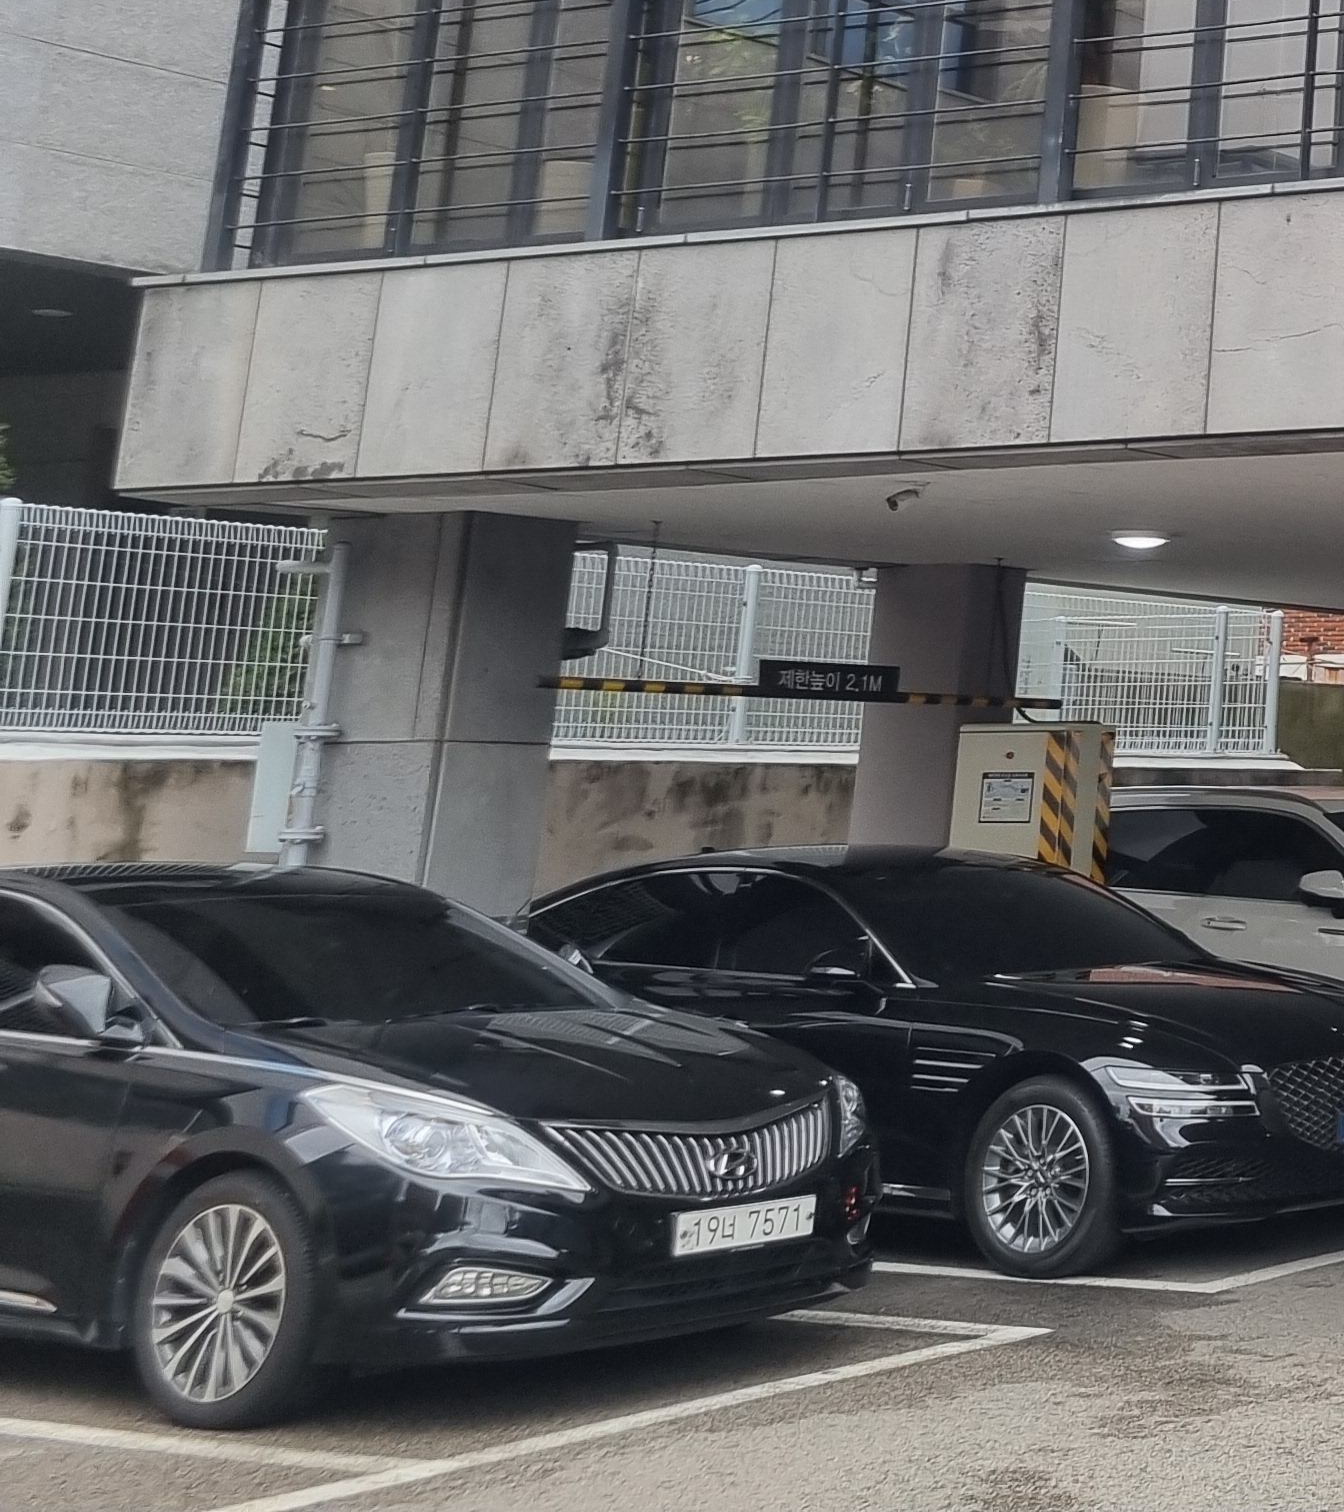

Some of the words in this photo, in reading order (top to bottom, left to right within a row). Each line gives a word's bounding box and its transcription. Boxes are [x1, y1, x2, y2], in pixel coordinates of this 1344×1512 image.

[778, 668, 841, 692] 제한높이
[845, 673, 883, 692] 2.1M
[693, 1214, 737, 1247] 19너
[748, 1204, 802, 1239] 7571
